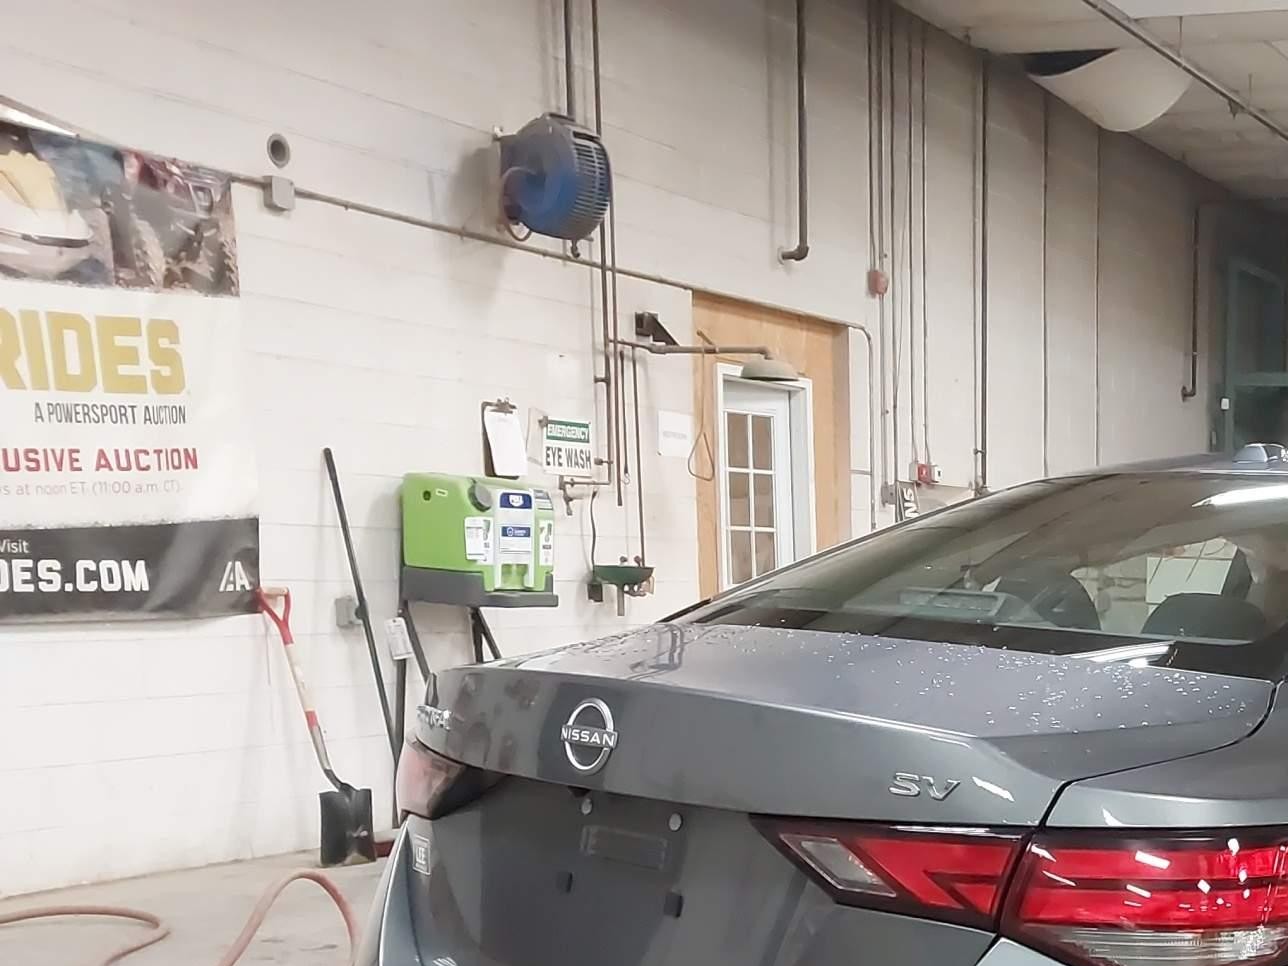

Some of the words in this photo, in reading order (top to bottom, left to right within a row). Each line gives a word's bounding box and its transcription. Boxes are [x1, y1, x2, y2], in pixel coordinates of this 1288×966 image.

[34, 402, 45, 423] A
[47, 402, 137, 425] POWERSPORT
[143, 405, 186, 425] AUCTION
[547, 423, 589, 440] EMERGENCY
[95, 447, 198, 472] AUCTION
[545, 446, 563, 467] EYE
[564, 447, 592, 470] WASH
[561, 727, 615, 748] NISSAN
[889, 771, 961, 801] SV
